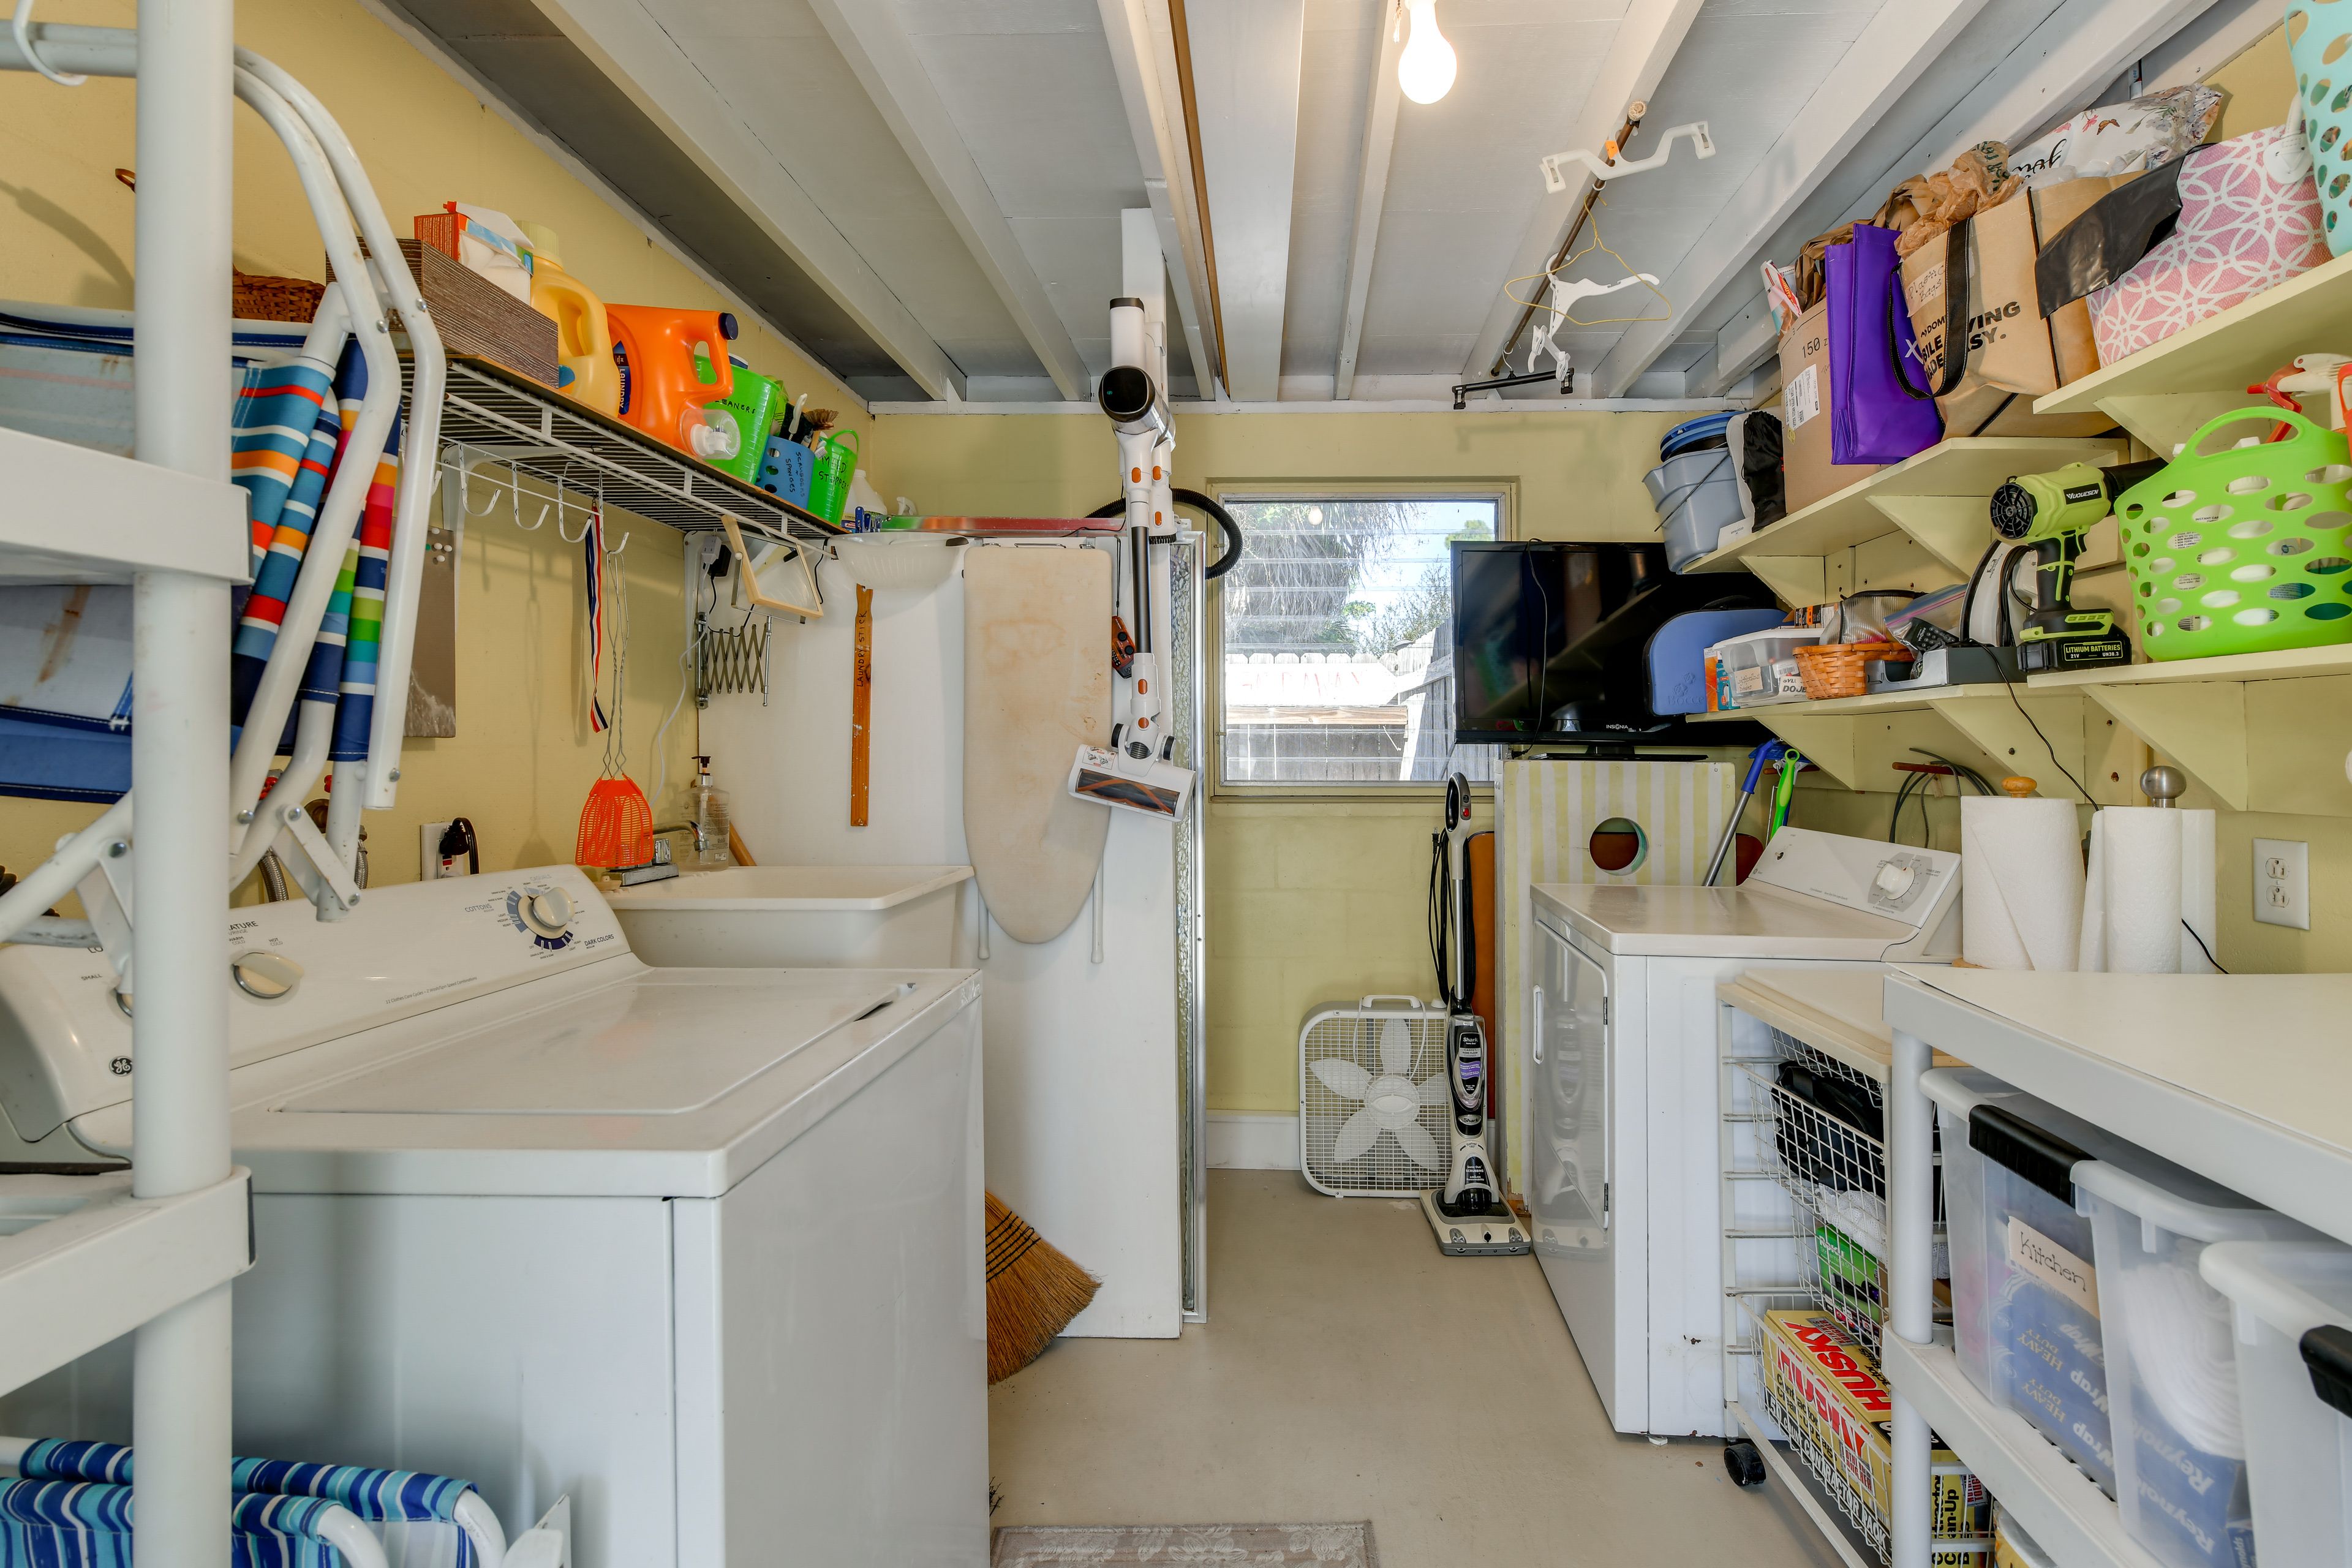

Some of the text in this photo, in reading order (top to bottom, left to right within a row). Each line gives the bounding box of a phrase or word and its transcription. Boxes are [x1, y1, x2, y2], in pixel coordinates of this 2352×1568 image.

[1803, 337, 1820, 358] 150
[1922, 334, 1943, 364] BILE
[715, 399, 756, 414] EANERS
[786, 458, 795, 492] SPONGES
[859, 611, 867, 643] STICK
[465, 903, 492, 912] COTTONS
[229, 921, 258, 930] ATURE
[597, 934, 614, 943] COLORS
[2021, 1231, 2086, 1292] Kitchen
[2016, 1333, 2063, 1372] HEAVY
[2026, 1329, 2059, 1354] DUTY
[1784, 1321, 1891, 1411] HUSKY
[1777, 1336, 1870, 1457] HUSKY
[2021, 1382, 2066, 1423] HEAVY
[2029, 1378, 2061, 1404] DUTY
[2132, 1419, 2215, 1495] Reynol
[1804, 1439, 1860, 1515] CONTRACTOR
[1861, 1506, 1887, 1551] PACK
[1944, 1489, 1959, 1565] Can-Up
[2136, 1471, 2215, 1555] Reynol
